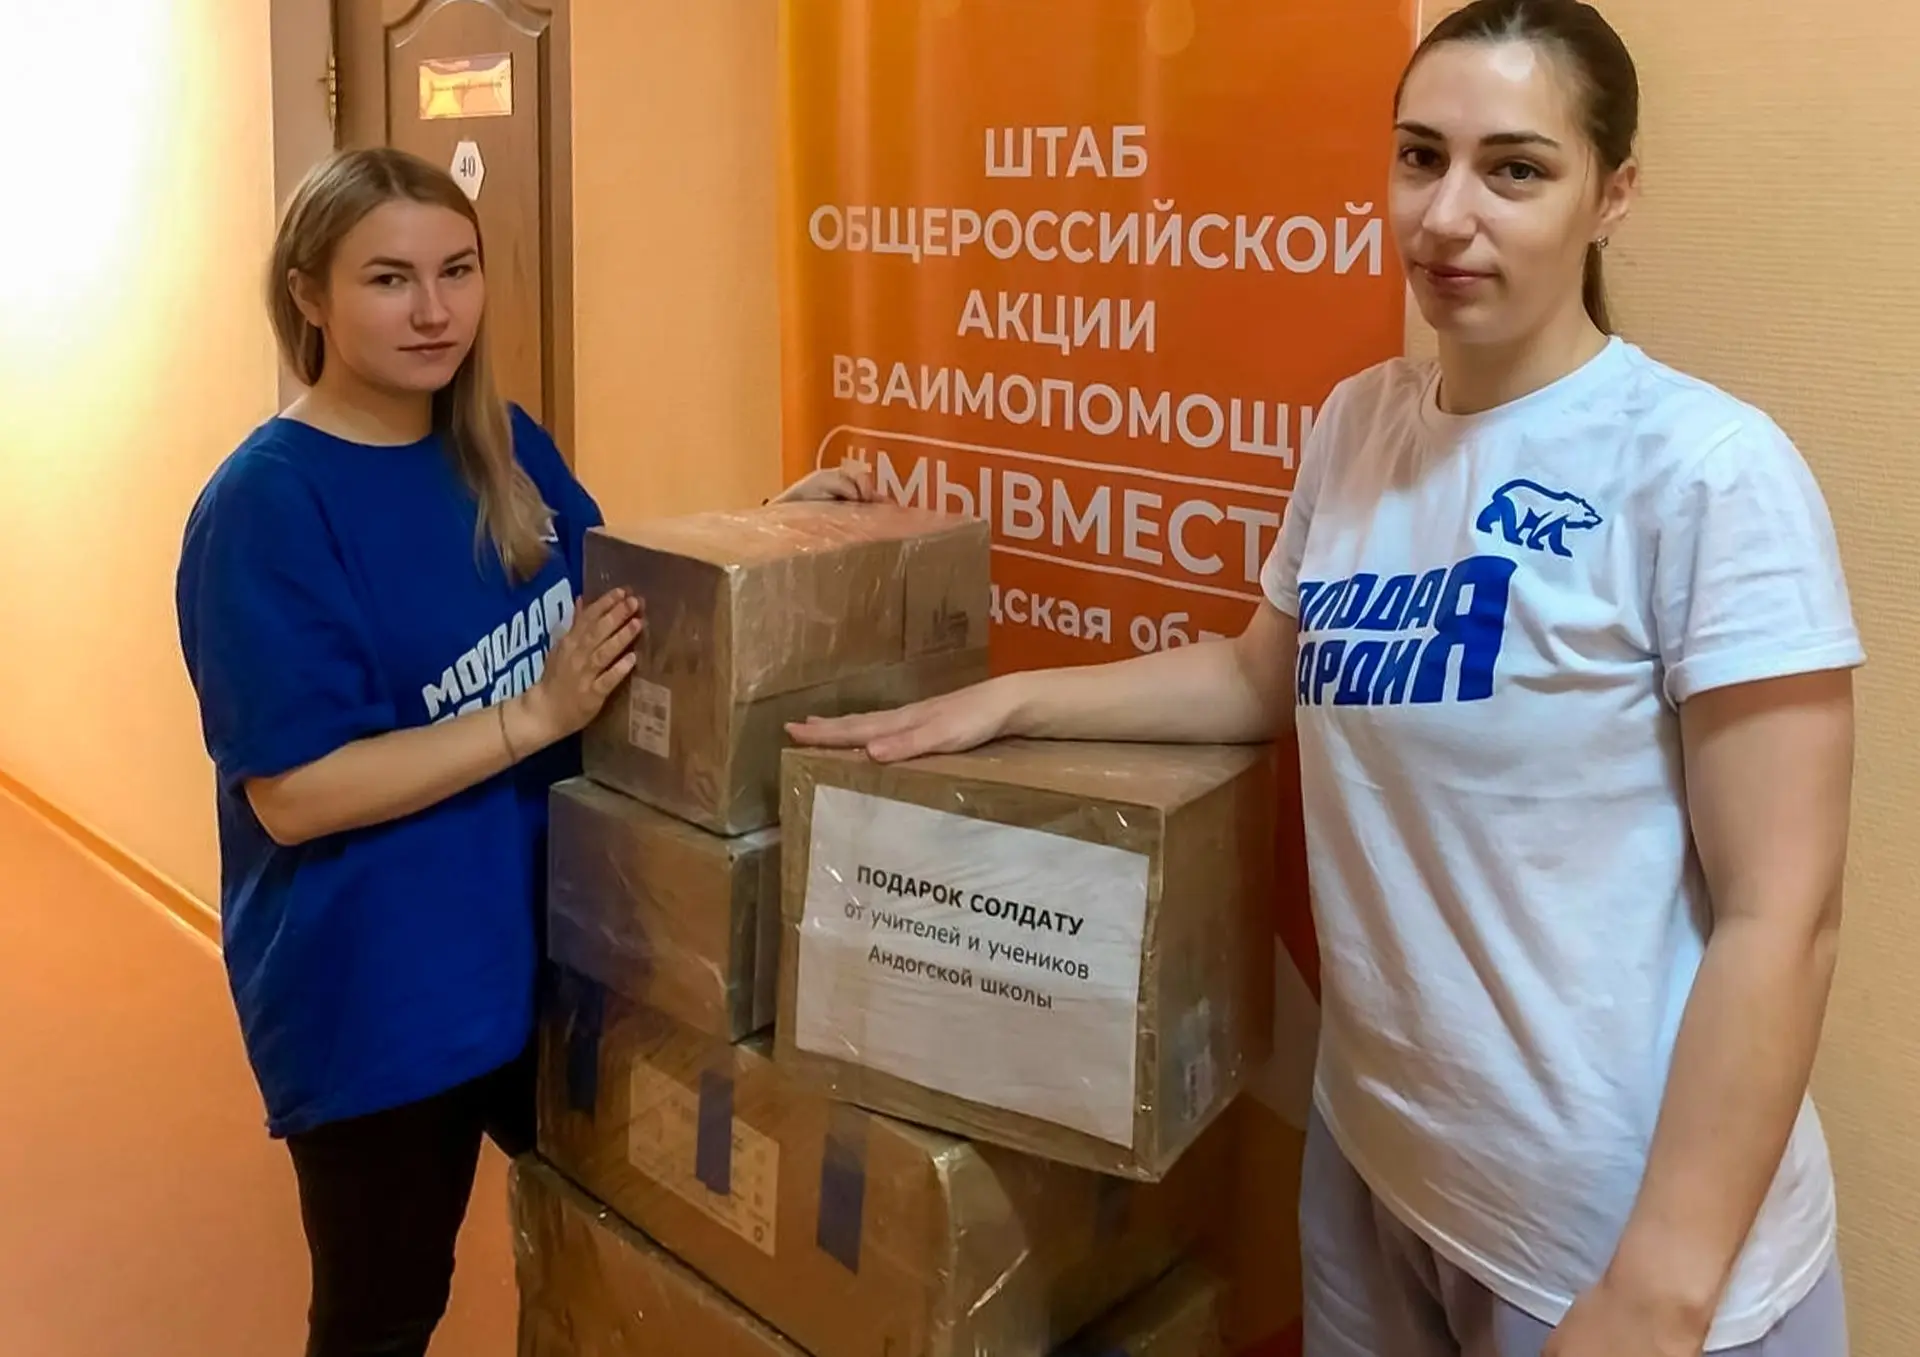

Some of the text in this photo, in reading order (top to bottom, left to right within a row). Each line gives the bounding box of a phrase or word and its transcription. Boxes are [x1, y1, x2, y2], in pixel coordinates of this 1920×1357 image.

[459, 155, 476, 178] 40
[985, 125, 1148, 178] ШТАБ
[808, 198, 1384, 276] ОБЩЕРОССИЙСКОЙ
[957, 289, 1156, 356] АКЦИИ
[1130, 612, 1226, 653] об
[857, 864, 1084, 936] ПОДАРОК СОЛДАТУ
[844, 902, 1089, 980] от учителей и учеников
[868, 943, 1053, 1009] Андогской школы
